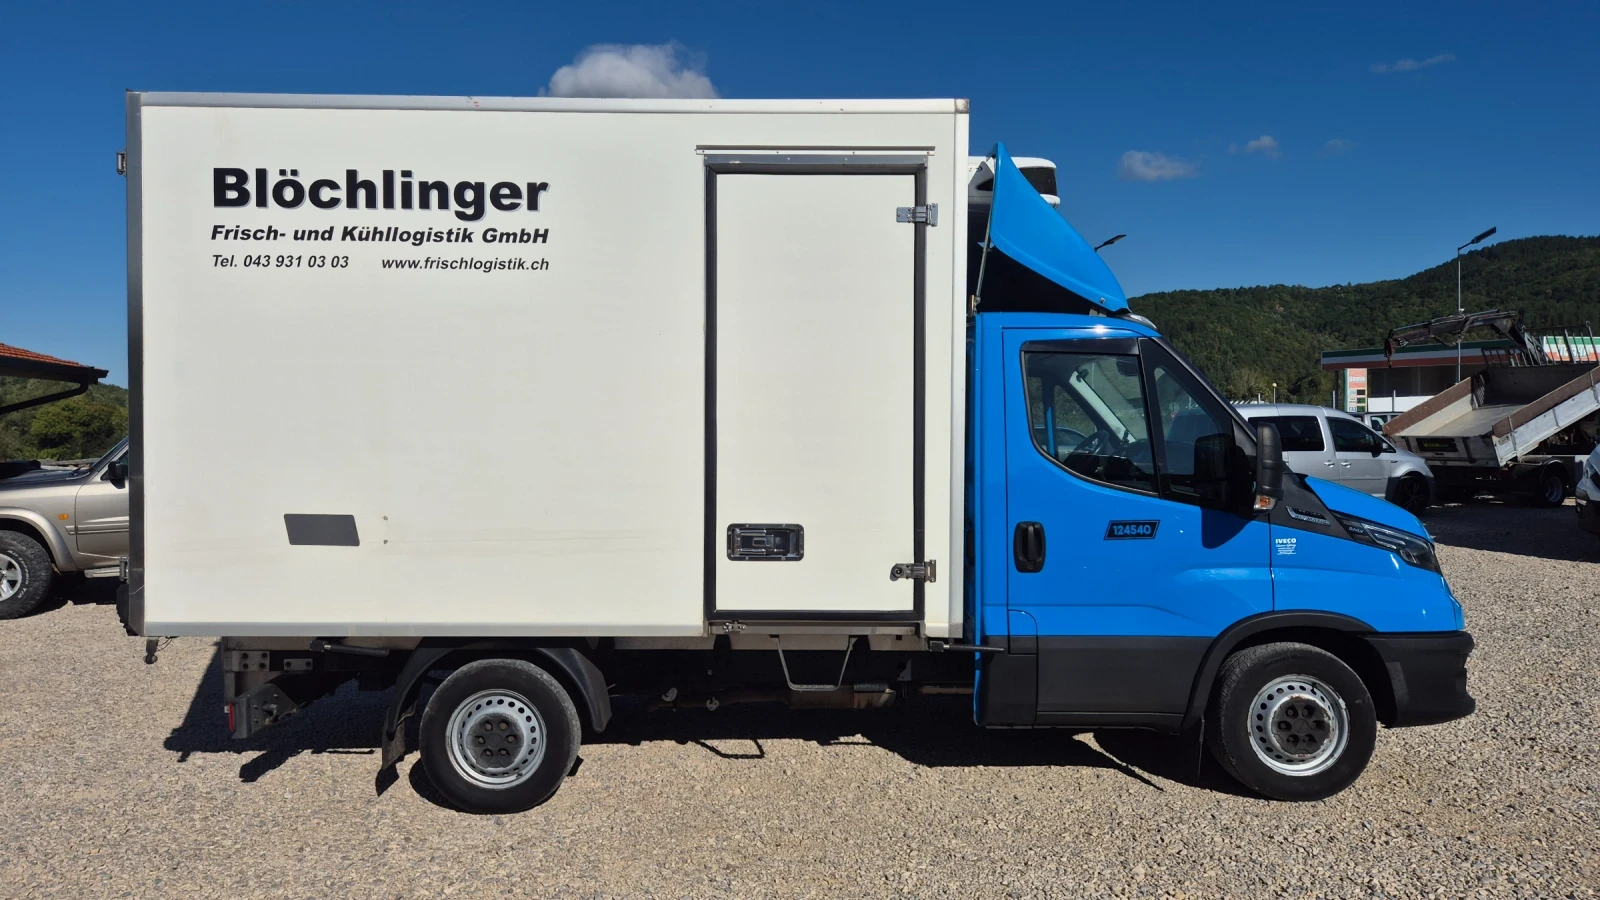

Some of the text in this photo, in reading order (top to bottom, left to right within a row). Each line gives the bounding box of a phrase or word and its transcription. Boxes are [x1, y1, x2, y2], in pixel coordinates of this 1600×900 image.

[212, 167, 551, 222] Blöchlinger
[211, 224, 550, 247] Frisch- und Kühllogistik GmbH
[212, 254, 350, 269] Tel. 043 931 03 03
[381, 256, 550, 274] www.frischlogistik.ch
[1113, 525, 1151, 536] 124540
